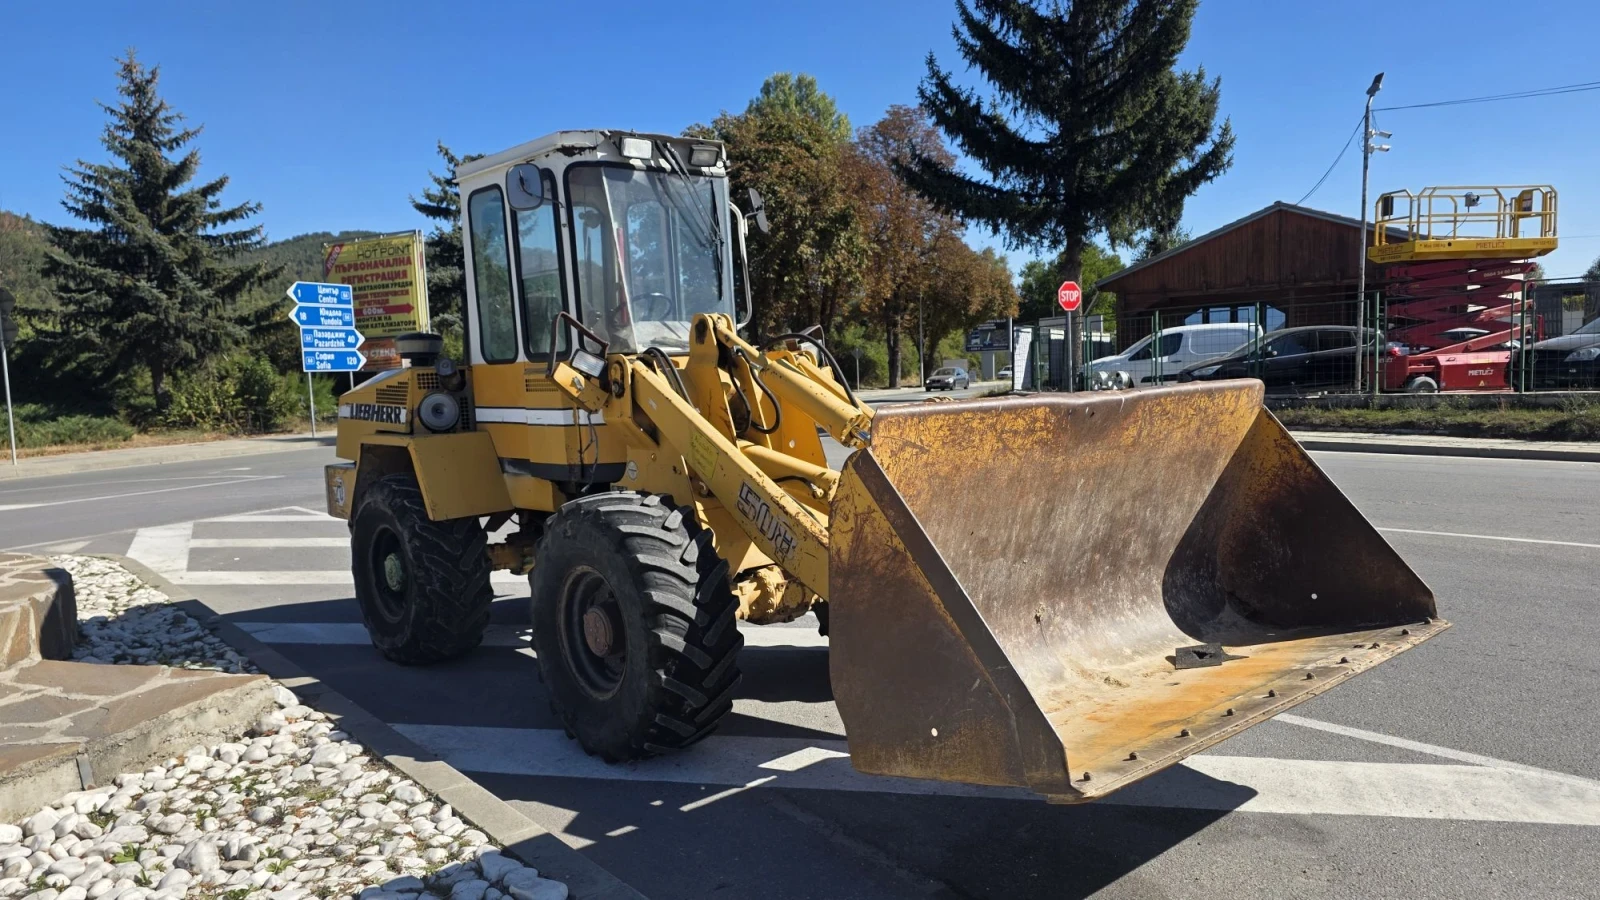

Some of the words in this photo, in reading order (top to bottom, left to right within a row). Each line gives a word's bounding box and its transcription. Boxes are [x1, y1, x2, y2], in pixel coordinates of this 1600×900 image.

[357, 249, 378, 259] HOT
[380, 244, 411, 257] POINT
[335, 256, 412, 273] ПЪРВОНАЧАЛНА
[341, 270, 408, 284] РЕГИСТРАЦИЯ
[298, 289, 302, 298] 1
[317, 285, 339, 296] Център
[1060, 290, 1079, 302] STOP
[318, 294, 338, 304] Centre
[299, 312, 307, 321] 18
[320, 308, 342, 317] Юндола
[320, 316, 343, 326] Yundola
[313, 329, 346, 339] Пазарджик
[347, 335, 356, 344] 40
[314, 339, 346, 347] Pazardzhik
[315, 351, 335, 361] София
[346, 356, 358, 365] 120
[316, 360, 332, 370] Sofia
[350, 402, 402, 425] LIEBHERR
